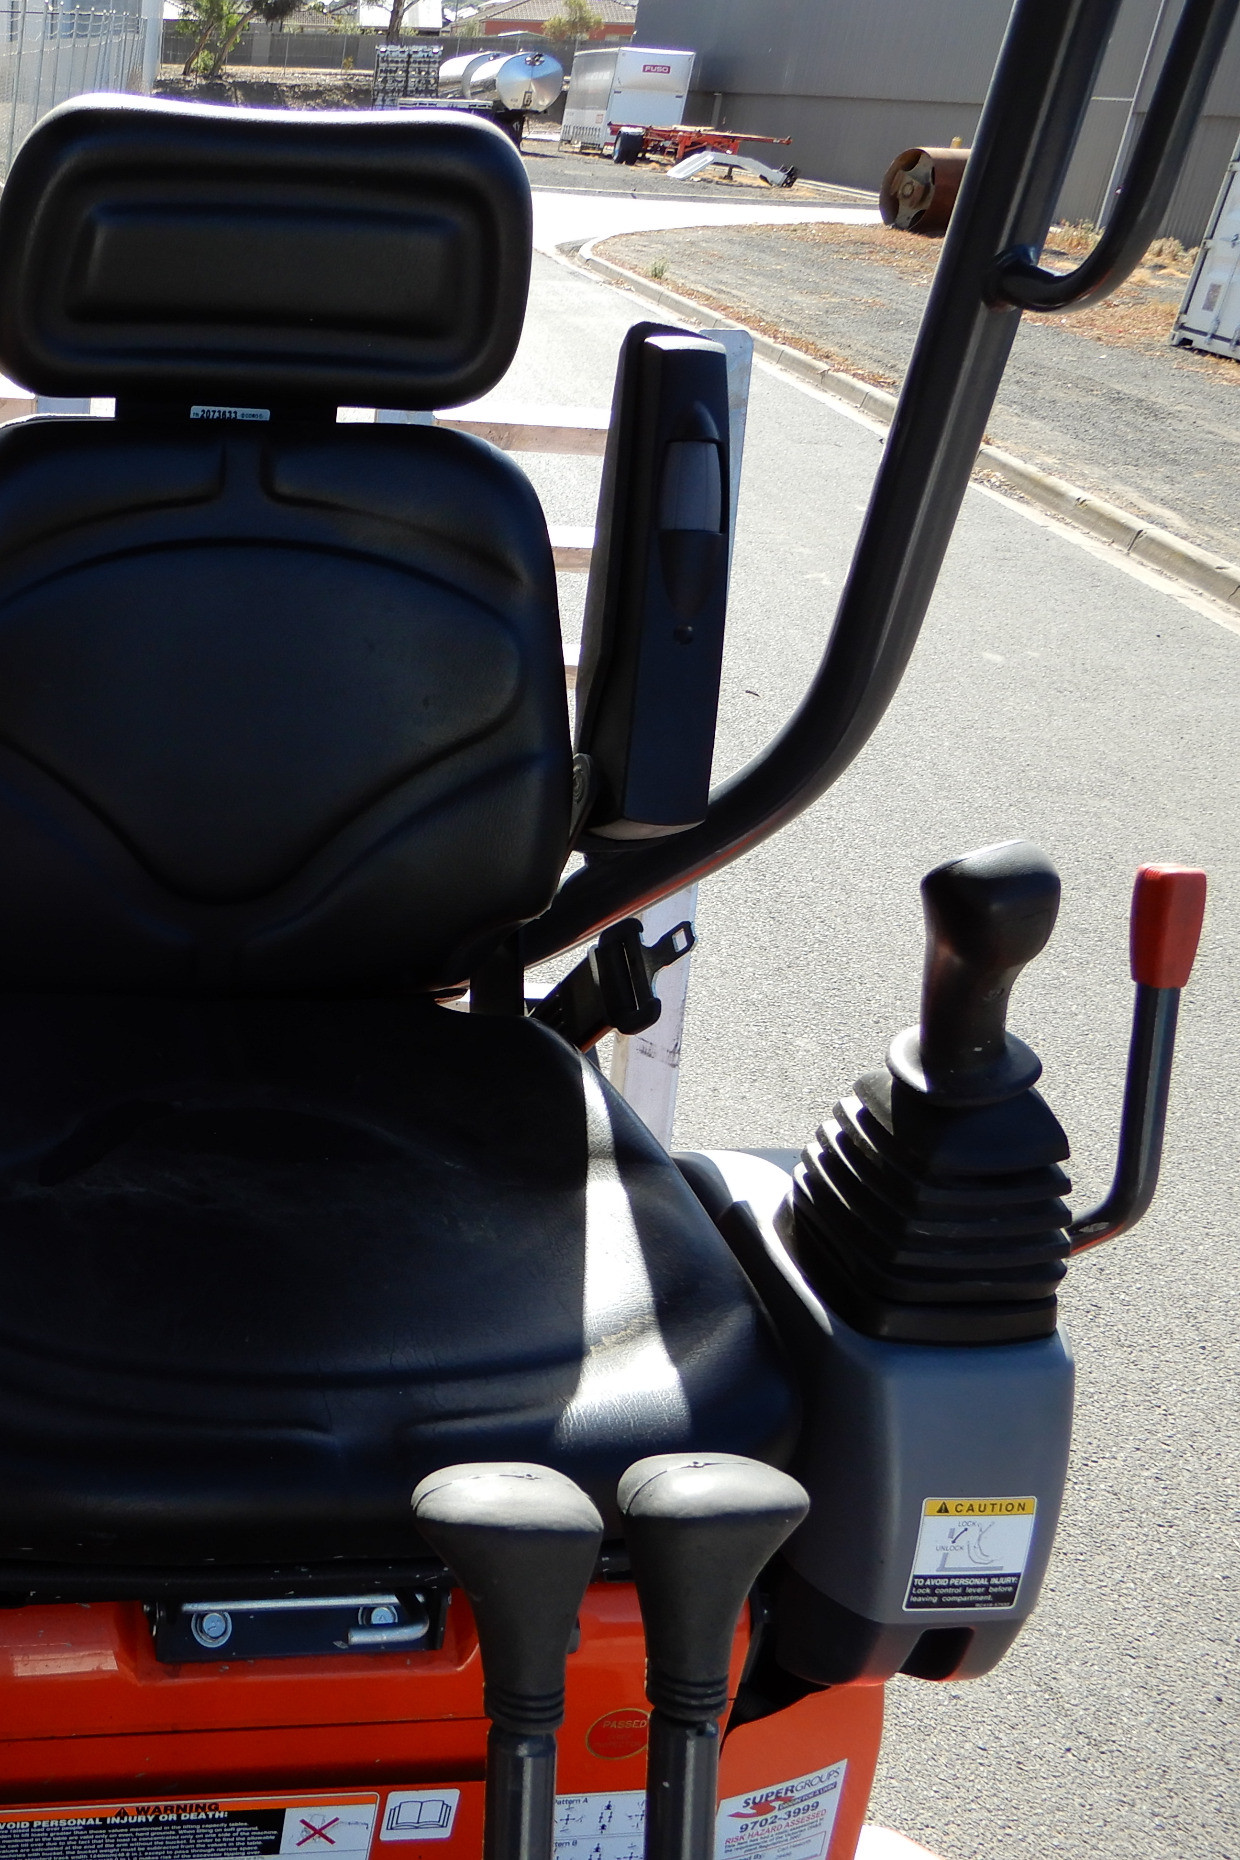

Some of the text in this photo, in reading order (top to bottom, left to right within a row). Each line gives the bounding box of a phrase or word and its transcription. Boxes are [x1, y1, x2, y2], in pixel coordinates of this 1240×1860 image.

[954, 1502, 1026, 1513] CAUTION
[603, 1720, 646, 1728] PASSED
[136, 1803, 220, 1816] WARNING
[739, 1801, 820, 1832] 9702-3999
[33, 1818, 102, 1828] PERSONAL
[107, 1814, 155, 1824] INJURY
[159, 1813, 176, 1821] OR
[180, 1811, 228, 1820] DEATH:
[725, 1834, 746, 1844] RISK
[748, 1824, 782, 1838] HAZARD
[784, 1809, 826, 1828] ASSESSED
